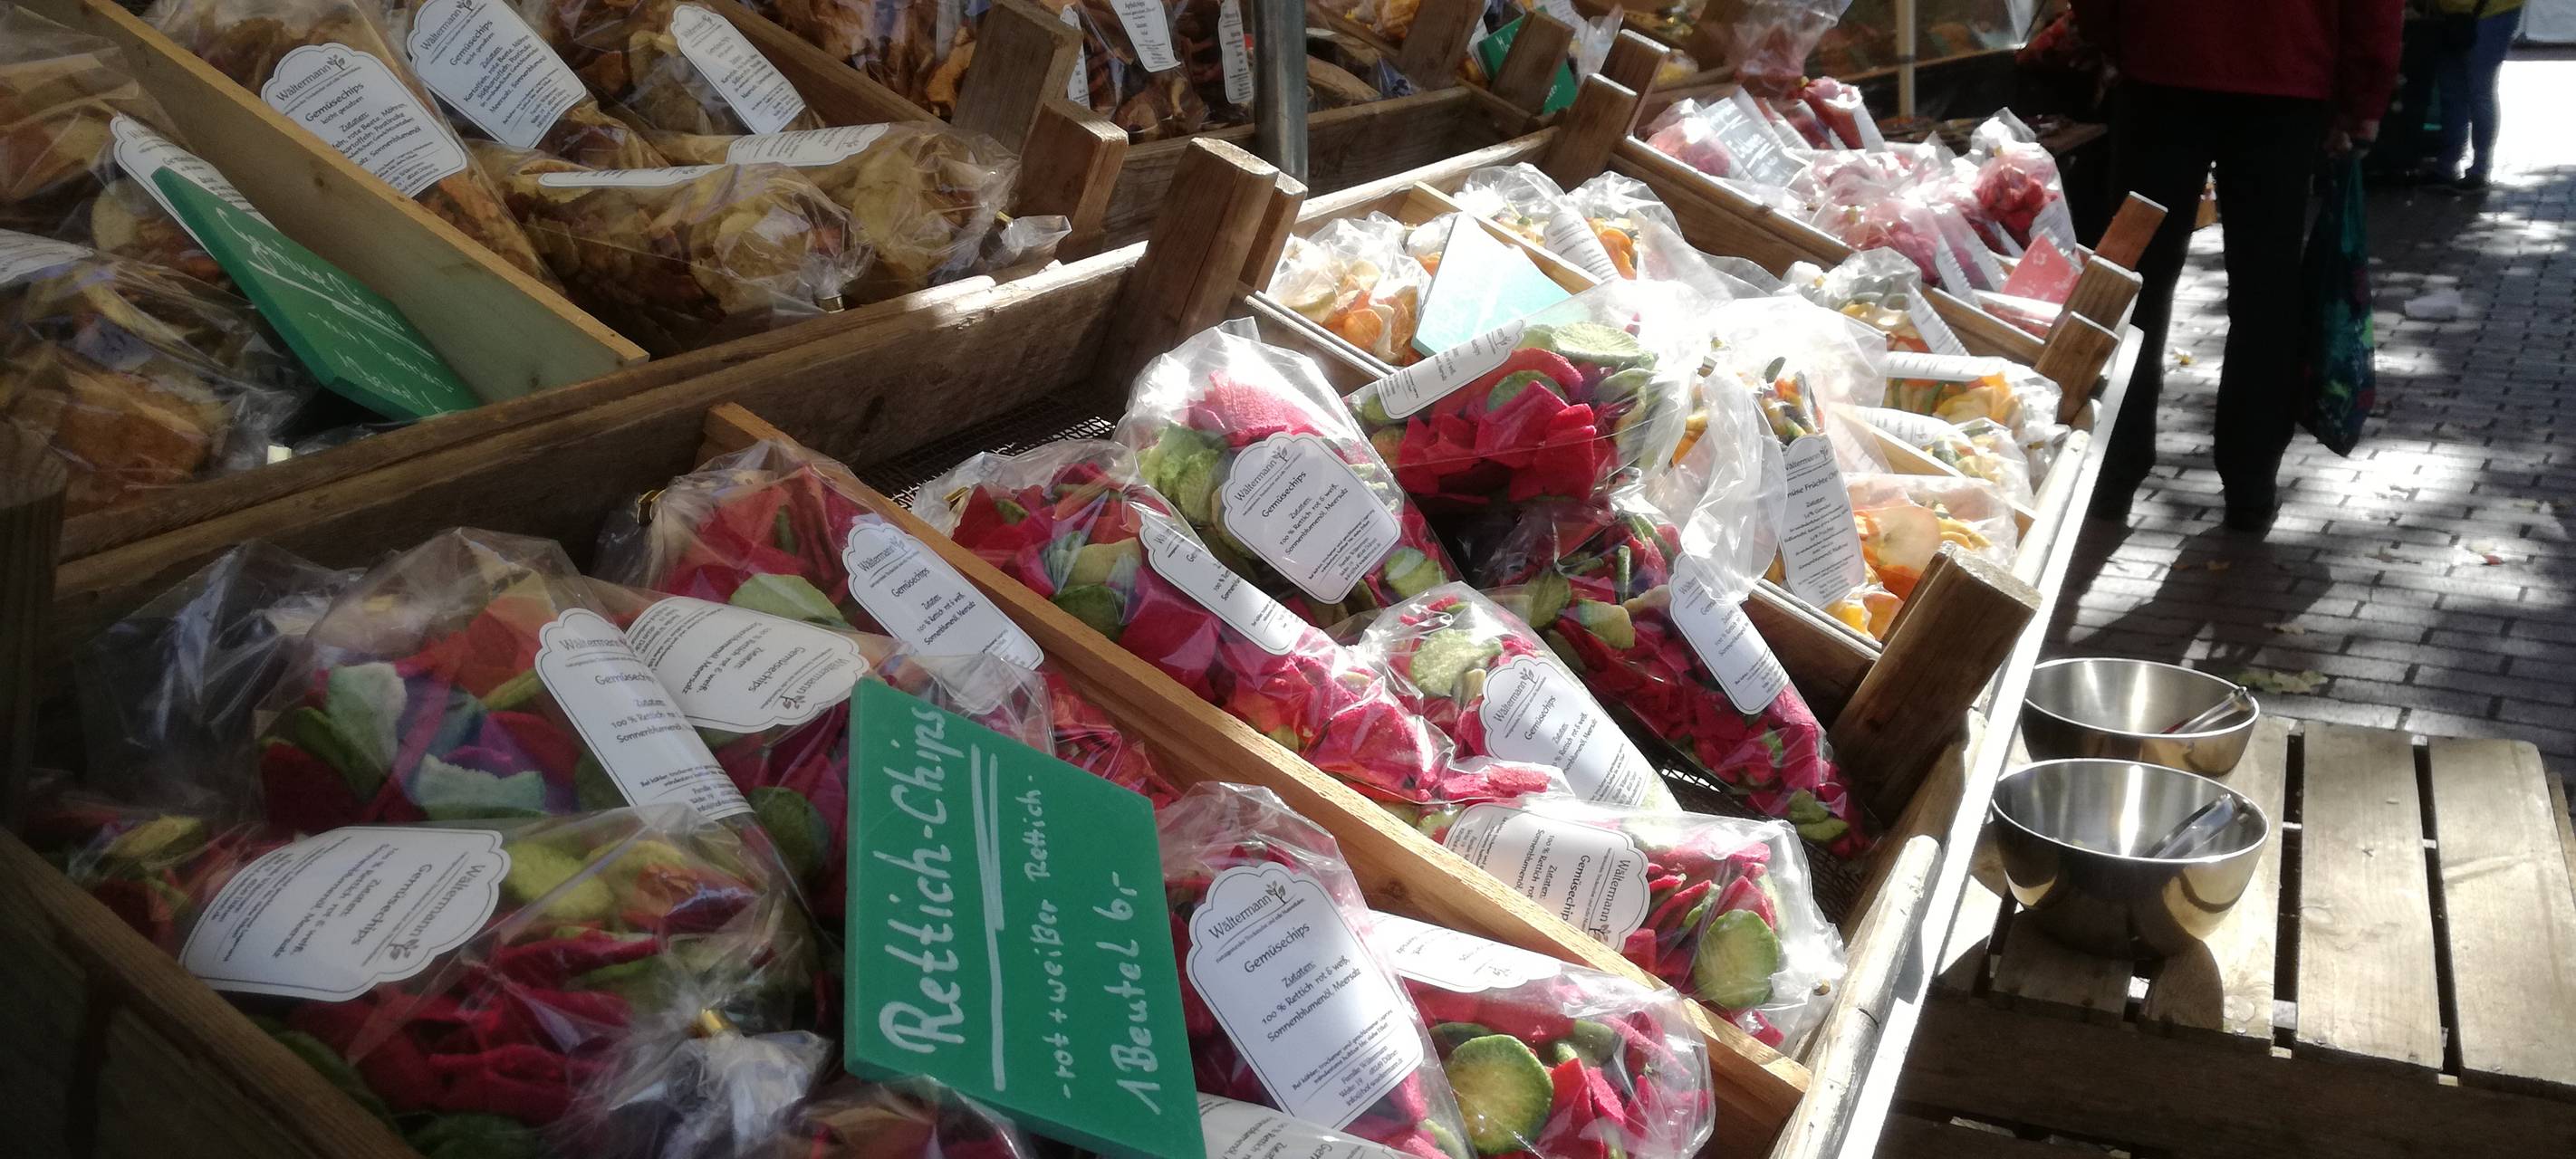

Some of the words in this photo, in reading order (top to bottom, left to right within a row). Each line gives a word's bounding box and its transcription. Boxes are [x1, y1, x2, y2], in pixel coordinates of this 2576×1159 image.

[420, 7, 462, 52] Wältermann
[449, 19, 494, 66] Gemüsechips
[275, 64, 332, 101] Wältermann
[304, 82, 365, 122] Gemüsechips
[1233, 458, 1278, 502] Wältermann
[1261, 470, 1308, 518] Gemüsechips
[1279, 535, 1291, 546] 100
[1293, 511, 1312, 531] Rettich
[1311, 500, 1322, 511] rot
[1284, 511, 1329, 555] Sonnenblumenöl,
[1324, 487, 1349, 512] Meersalz
[1288, 496, 1313, 520] Zutaten:
[890, 567, 932, 599] Gemüsechips
[746, 646, 807, 694] Gemüsechips
[1493, 680, 1527, 723] Wältermann
[1523, 694, 1557, 741] Gemüsechips
[873, 706, 966, 1054] Rettich-Chips
[1514, 829, 1545, 891] Sonnenblumenöl,
[1531, 854, 1547, 883] Rettich
[1540, 864, 1559, 900] Zutaten:
[338, 876, 382, 918] Zutaten:
[350, 863, 433, 946] Gemüsechips
[409, 864, 486, 937] Wältermann
[1561, 854, 1591, 922] Gemüsechip
[1599, 859, 1631, 924] Wältermann
[271, 912, 315, 958] Meersalz
[1208, 894, 1273, 939] Wältermann
[1244, 922, 1312, 973] Gemüsechips
[1281, 960, 1317, 988] Zutaten:
[1261, 1010, 1278, 1025] 100
[1276, 1003, 1288, 1013] %
[1284, 982, 1313, 1007] Rettich
[1314, 972, 1327, 985] rot
[1265, 987, 1336, 1042] Sonnenblumenöl,
[1331, 967, 1362, 991] Meersalz
